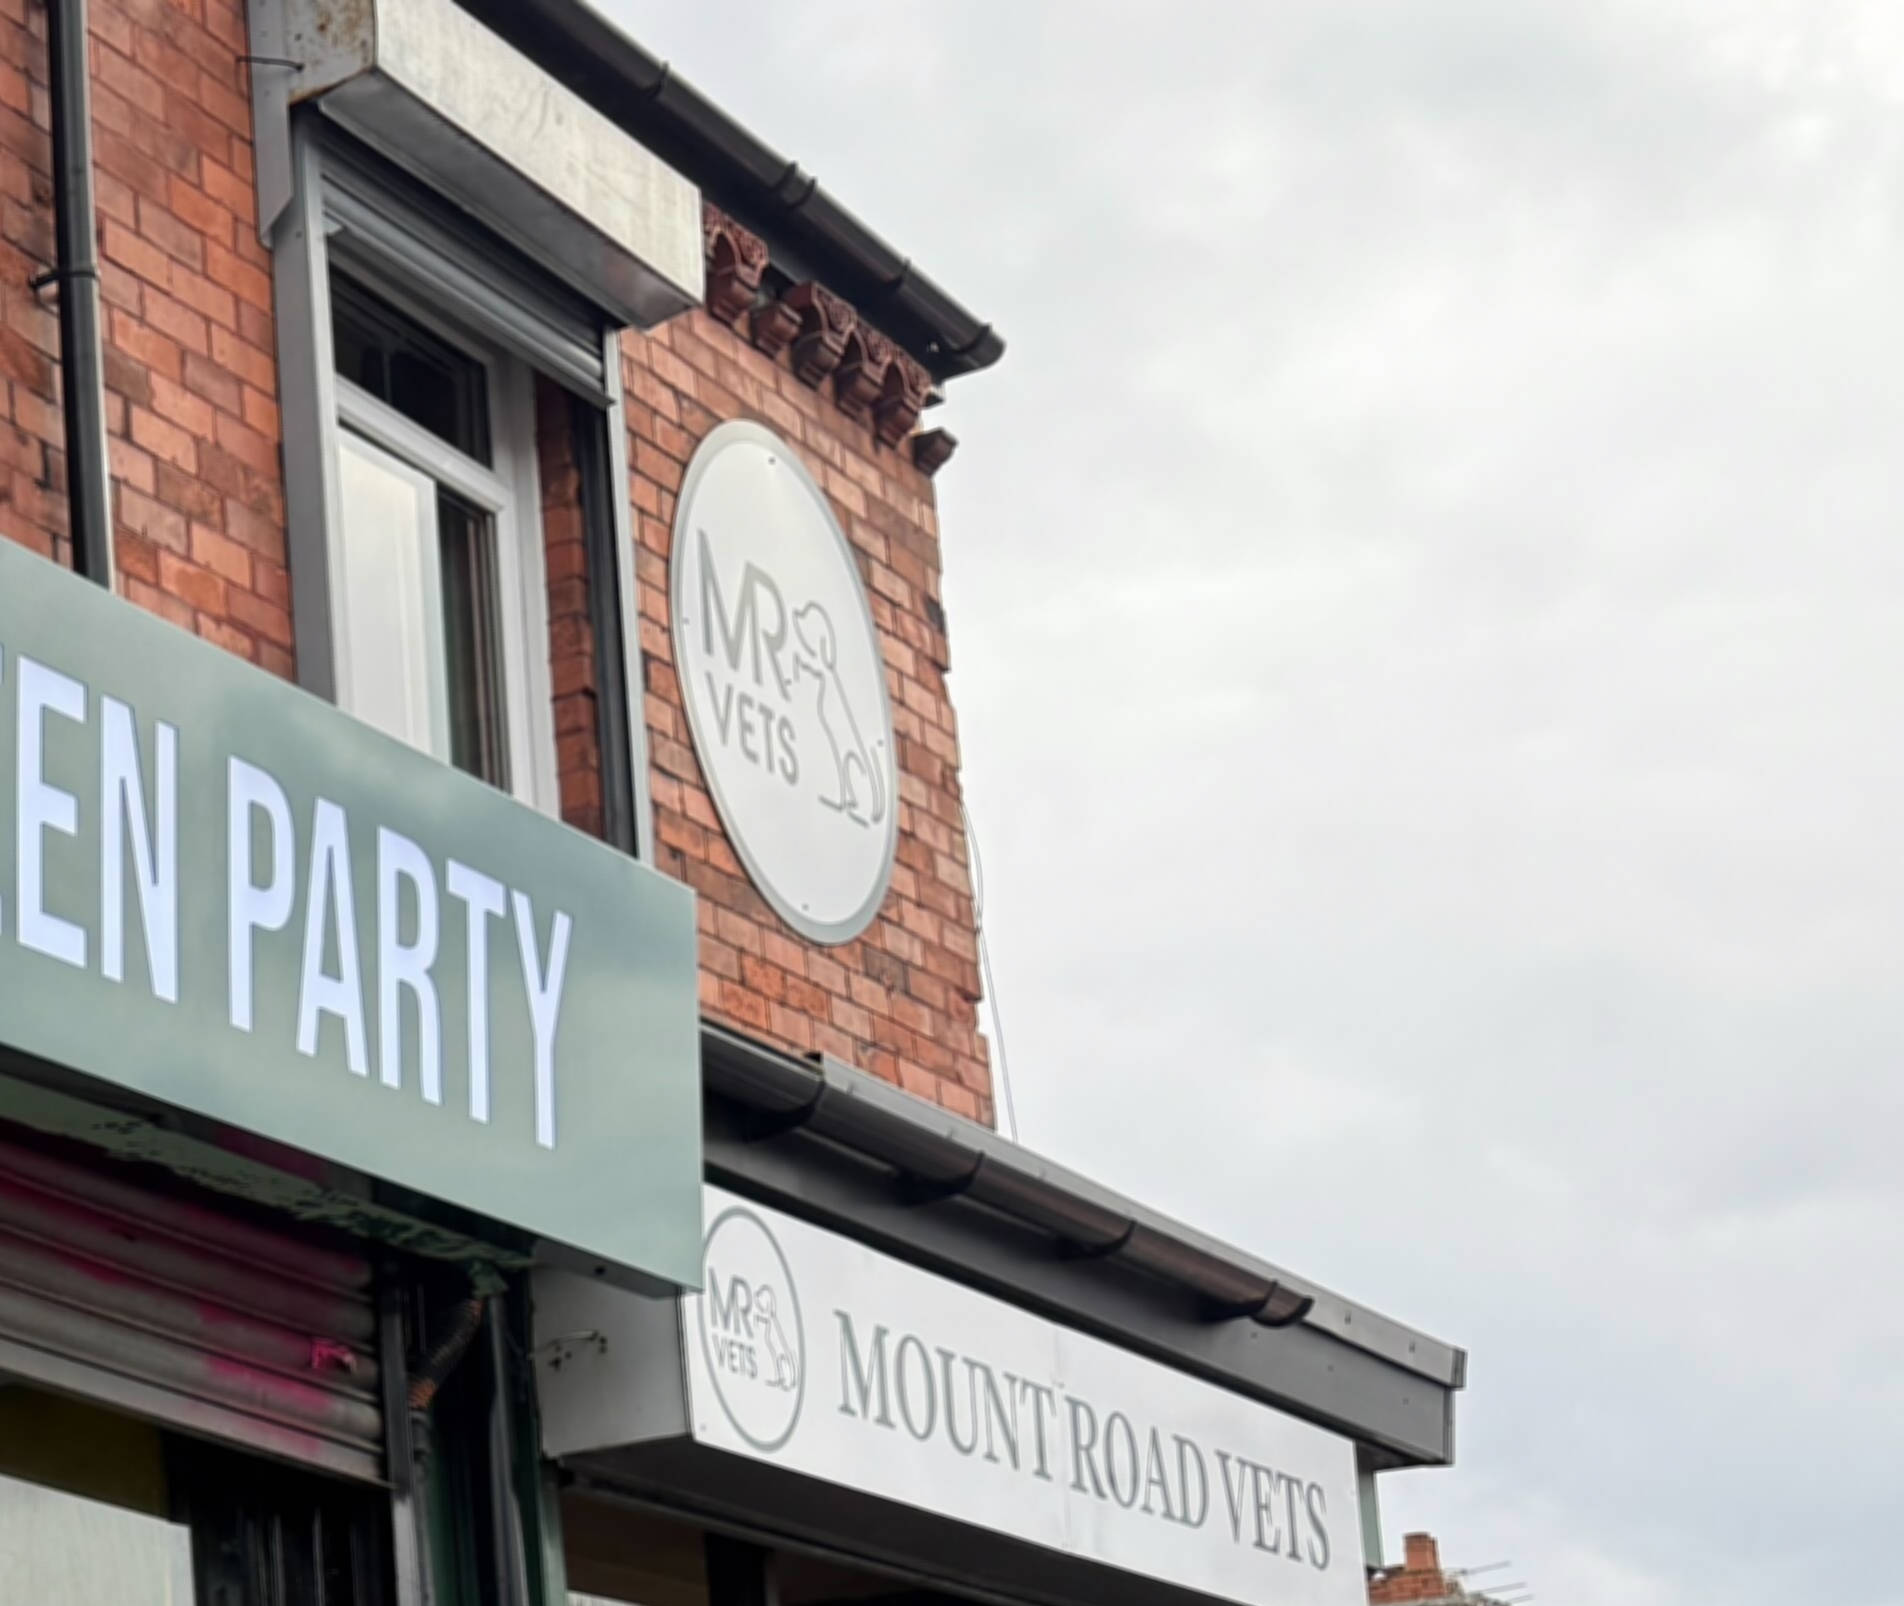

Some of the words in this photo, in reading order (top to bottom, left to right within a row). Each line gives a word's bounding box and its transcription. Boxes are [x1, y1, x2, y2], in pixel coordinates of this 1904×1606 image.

[697, 528, 792, 700] MR
[705, 671, 800, 786] VETS
[227, 755, 573, 1149] PARTY
[707, 1266, 755, 1340] MR
[711, 1332, 759, 1380] VETS
[833, 1309, 1058, 1482] MOUNT
[1064, 1395, 1210, 1530] ROAD
[1215, 1448, 1332, 1572] VETS
